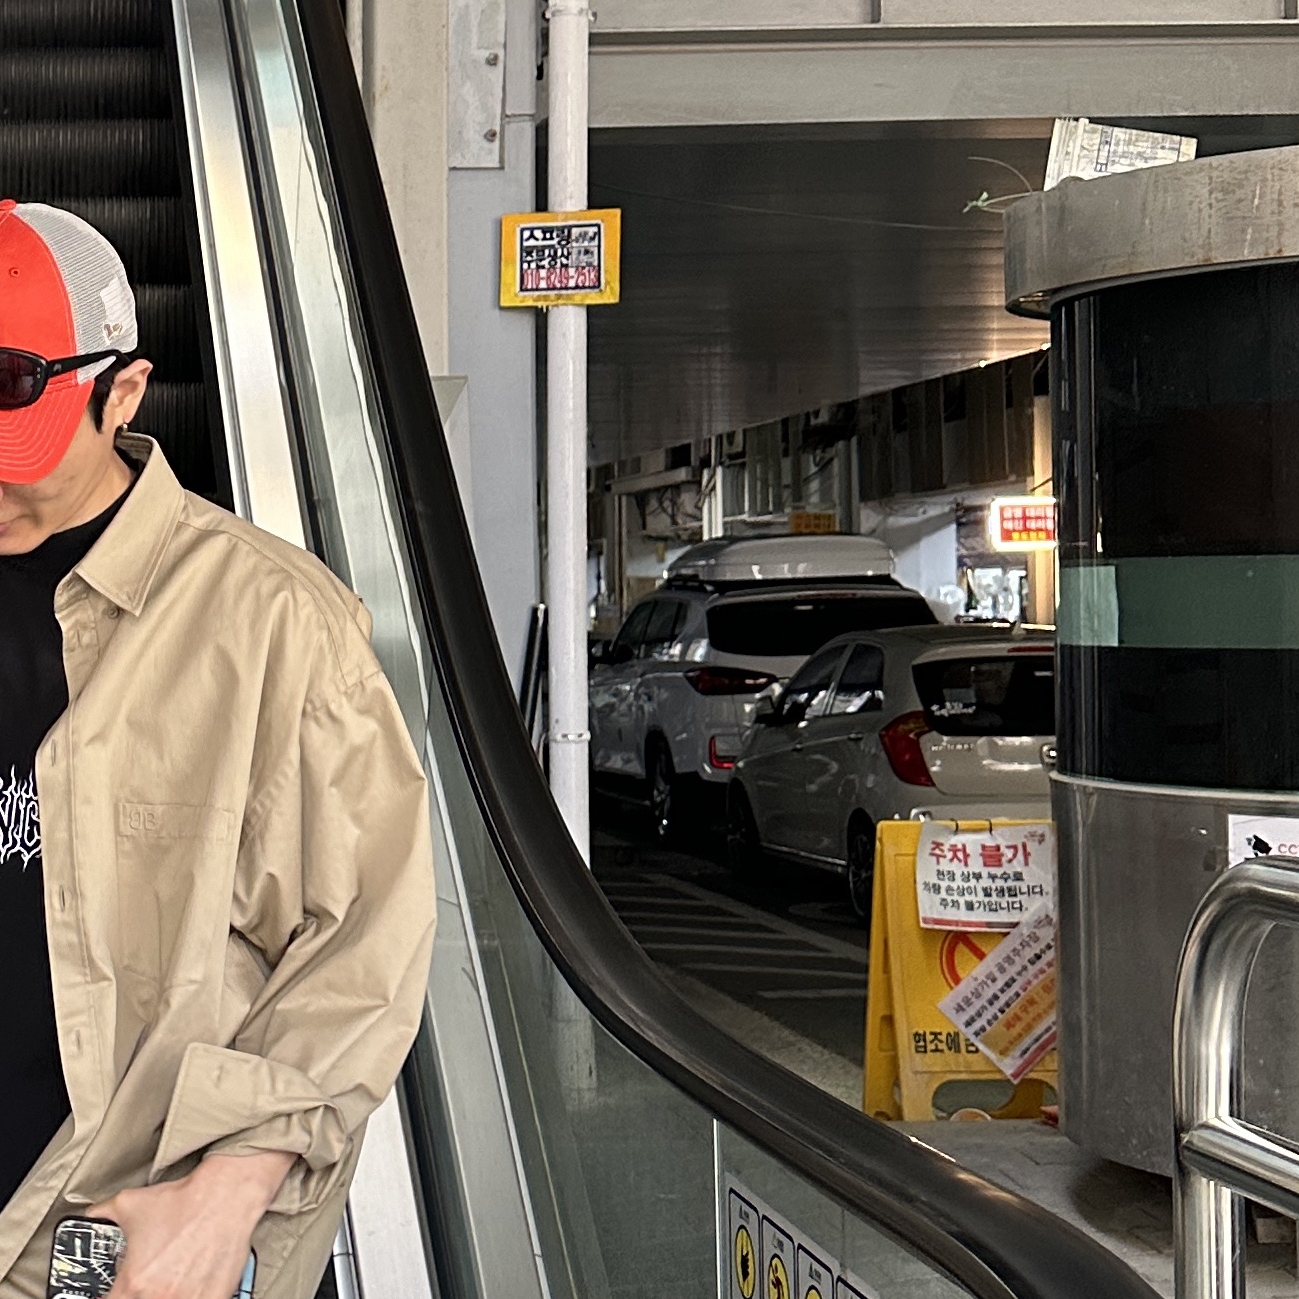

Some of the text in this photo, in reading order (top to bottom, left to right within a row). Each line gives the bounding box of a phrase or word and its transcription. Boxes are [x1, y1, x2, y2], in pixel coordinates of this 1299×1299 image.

[928, 840, 1032, 868] 주차 불가
[960, 870, 983, 883] 상부
[945, 883, 978, 897] 손상이
[939, 898, 960, 910] 주차
[912, 1030, 962, 1054] 협조에
